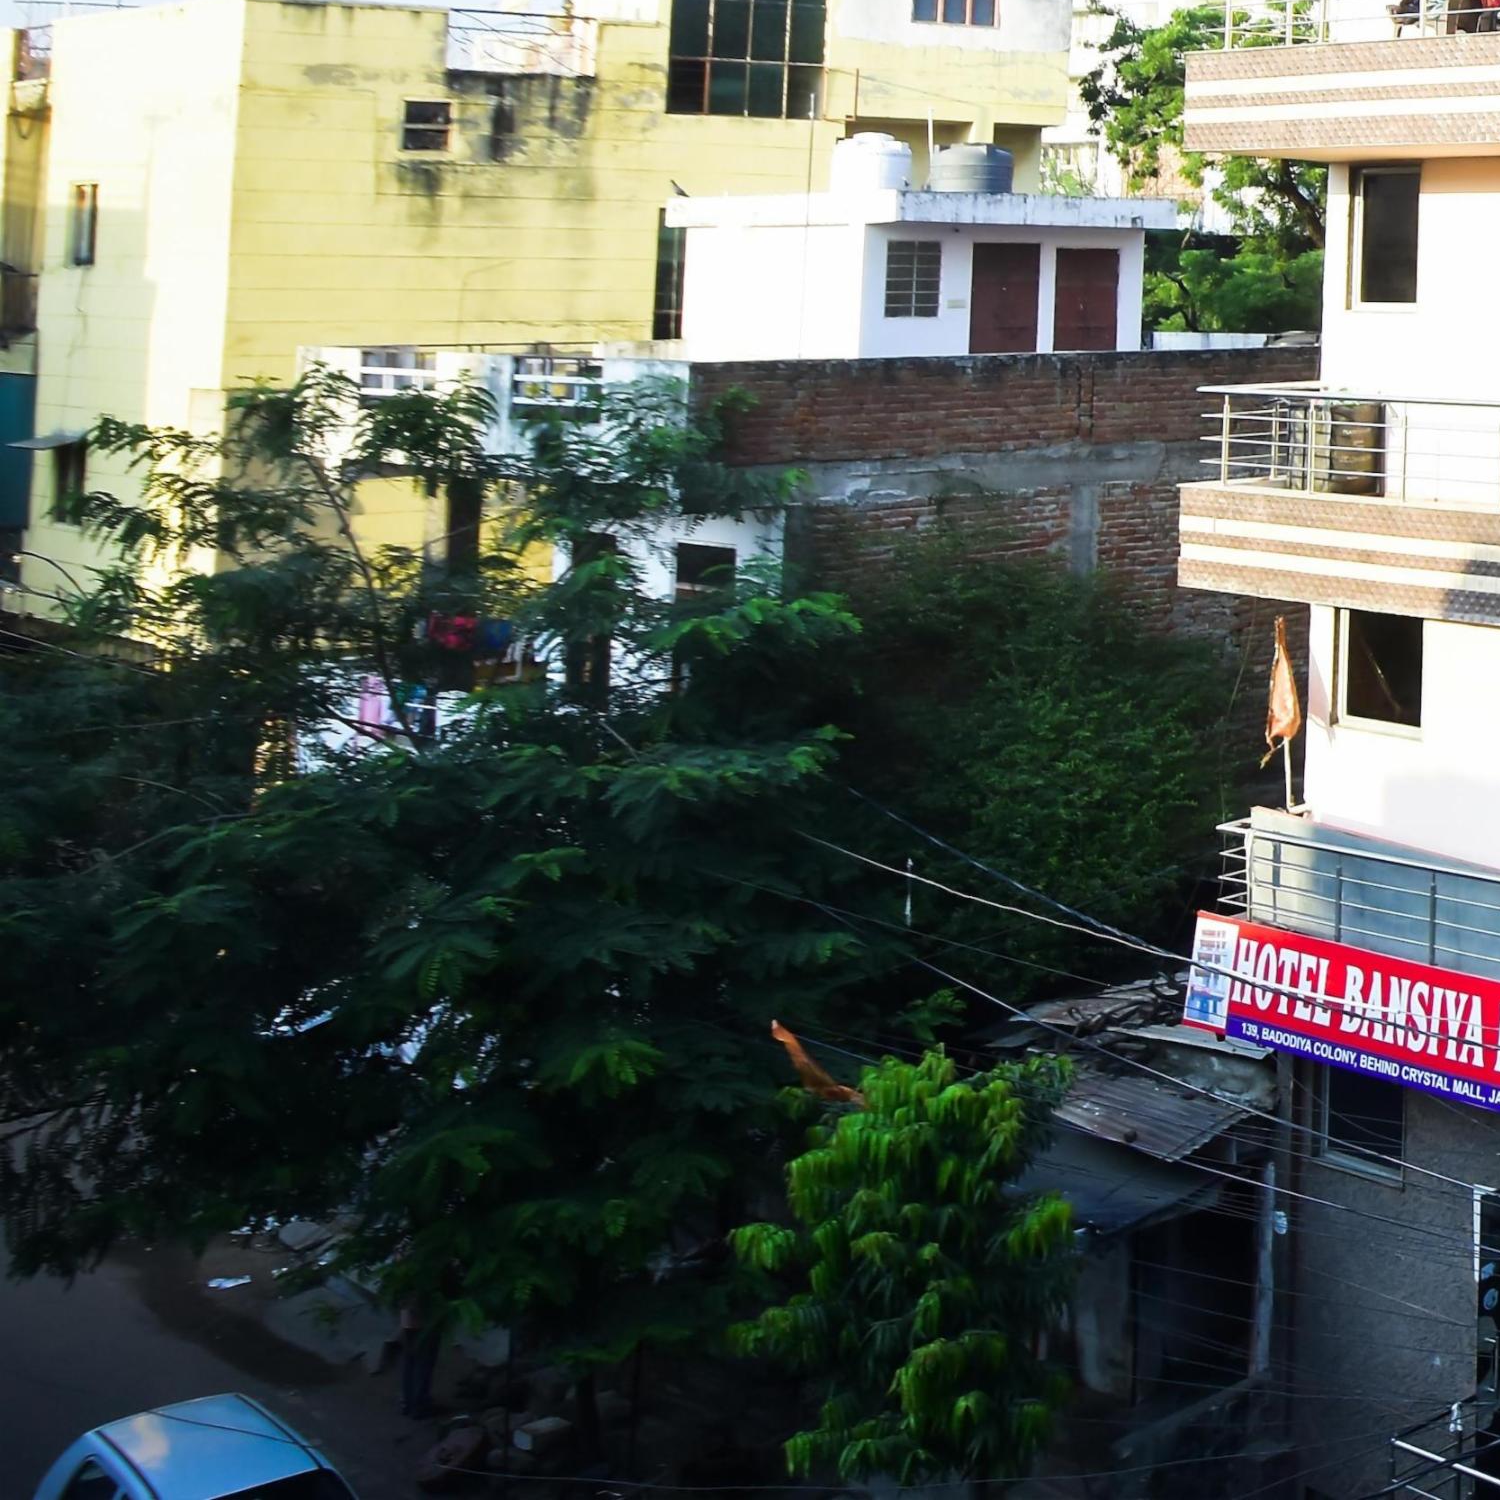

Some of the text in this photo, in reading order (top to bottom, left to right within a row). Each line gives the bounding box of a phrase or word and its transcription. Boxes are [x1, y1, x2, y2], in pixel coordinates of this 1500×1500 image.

[1231, 938, 1332, 1027] HOTEL
[1340, 965, 1485, 1068] BANSIYA
[1241, 1022, 1260, 1041] 139,
[1261, 1027, 1312, 1053] BADODIYA
[1313, 1042, 1358, 1068] COLONY,
[1359, 1055, 1400, 1078] BEHIND
[1401, 1066, 1451, 1092] CRYSTAL
[1452, 1079, 1486, 1103] MALL,
